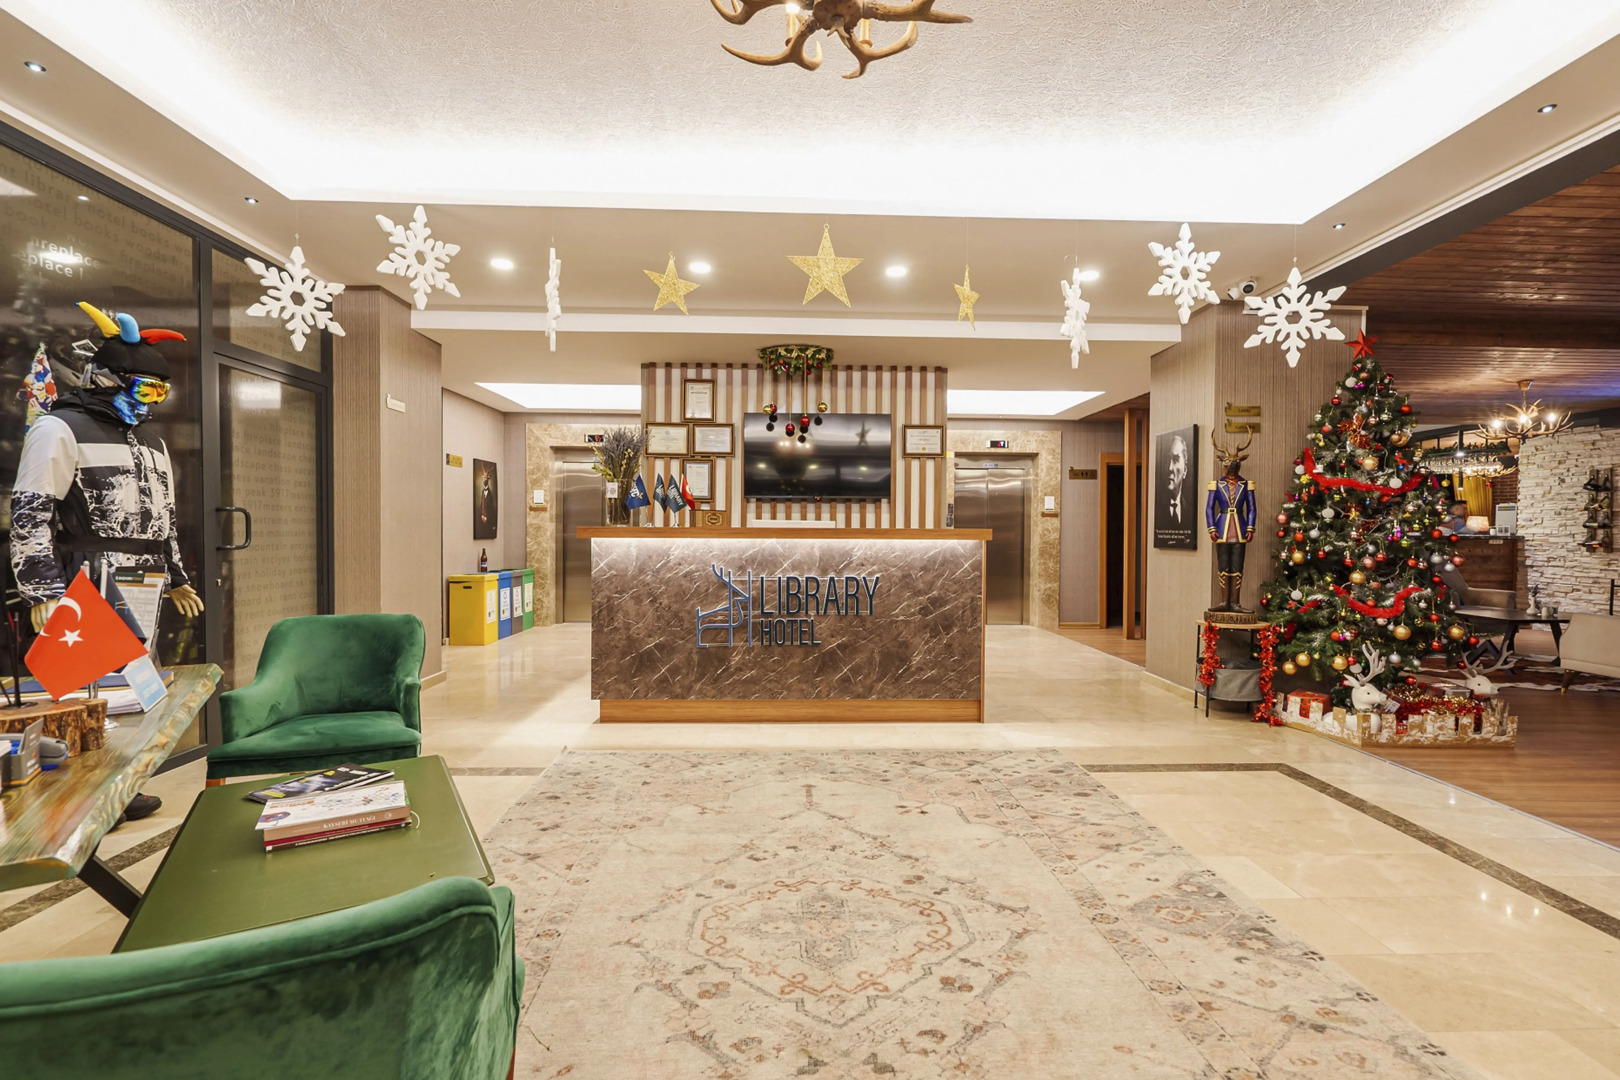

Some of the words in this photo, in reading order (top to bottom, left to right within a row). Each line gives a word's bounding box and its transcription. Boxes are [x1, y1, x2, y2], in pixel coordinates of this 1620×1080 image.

[245, 487, 266, 498] peak
[255, 567, 286, 578] holiday
[246, 579, 293, 593] snowboard
[760, 574, 880, 616] LIBRARY
[760, 618, 821, 647] HOTEL
